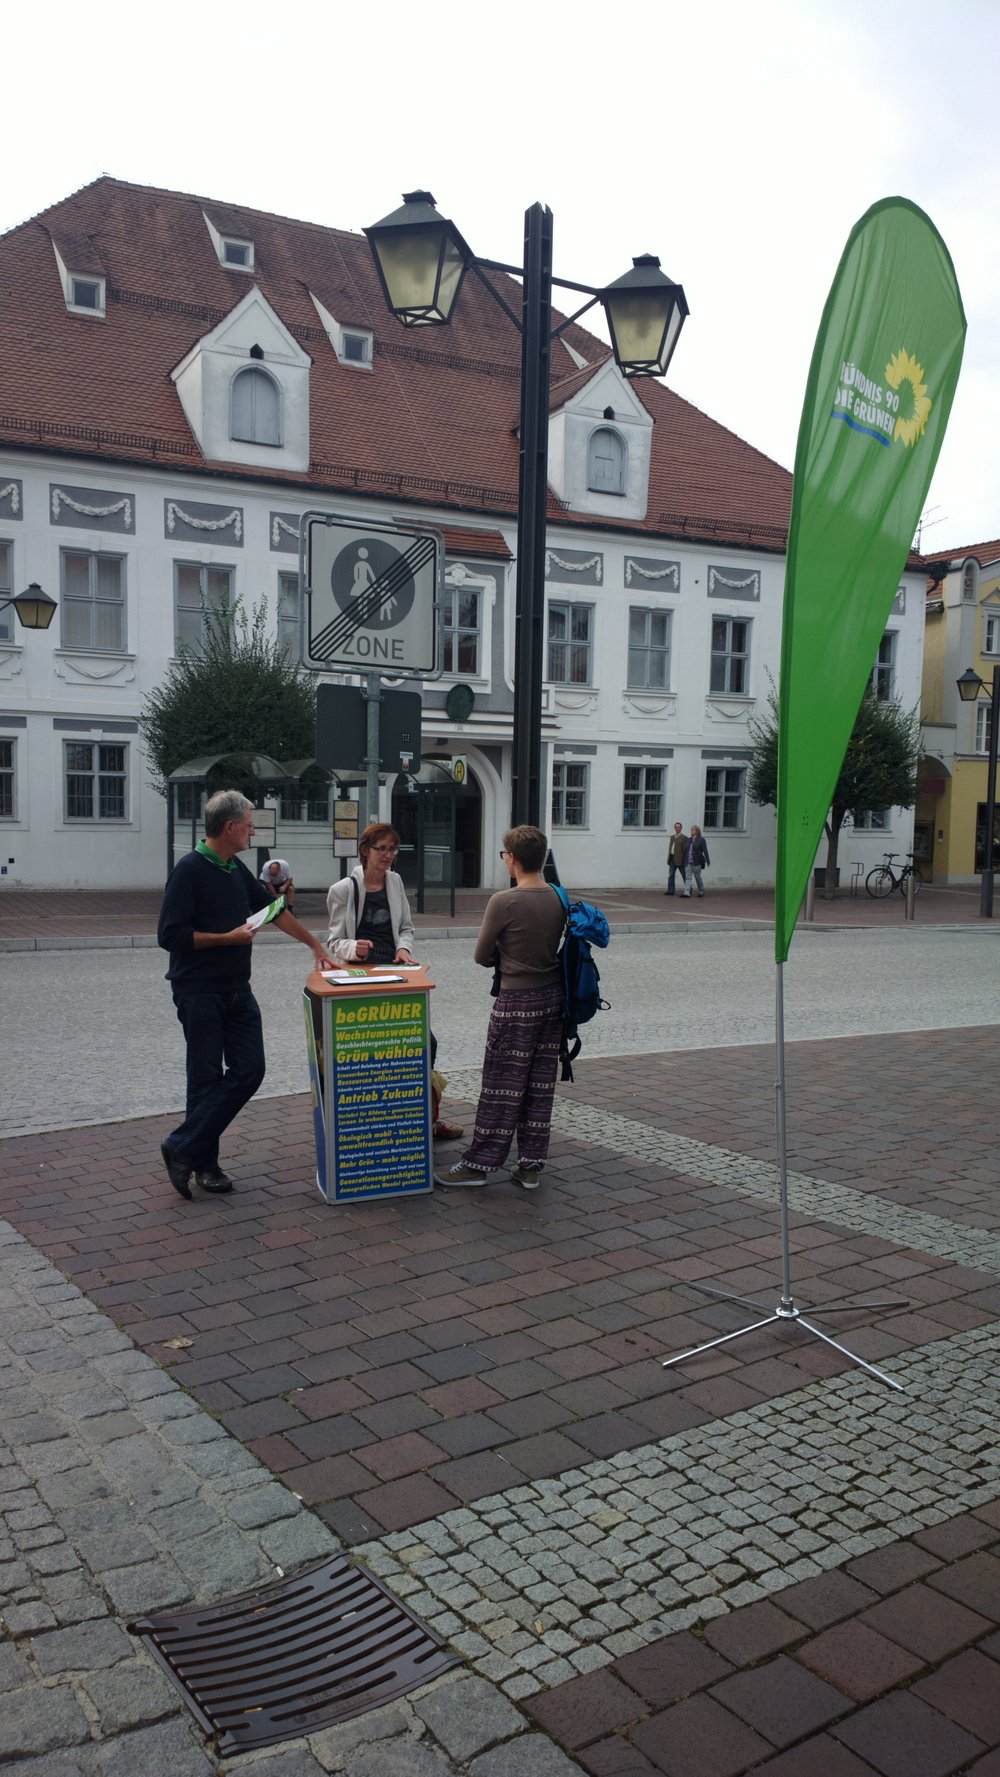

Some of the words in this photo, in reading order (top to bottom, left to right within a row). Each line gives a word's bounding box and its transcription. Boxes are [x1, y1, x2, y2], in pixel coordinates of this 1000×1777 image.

[841, 361, 882, 402] ÜNDNIS
[886, 391, 900, 412] 90
[854, 398, 895, 435] GRÜNEN
[342, 634, 405, 660] ZONE
[336, 1002, 422, 1024] beGRÜNER
[336, 1026, 422, 1041] Wachstumswende
[337, 1039, 401, 1050] Geschlechtergerechte
[337, 1050, 369, 1064] Grün
[374, 1045, 423, 1060] wählen
[338, 1078, 372, 1086] Ressourcen
[338, 1091, 378, 1105] Antrieb
[382, 1086, 424, 1100] Zukunft
[400, 1127, 423, 1135] Verkehr
[340, 1161, 357, 1169] Mehr
[401, 1153, 425, 1162] möglich
